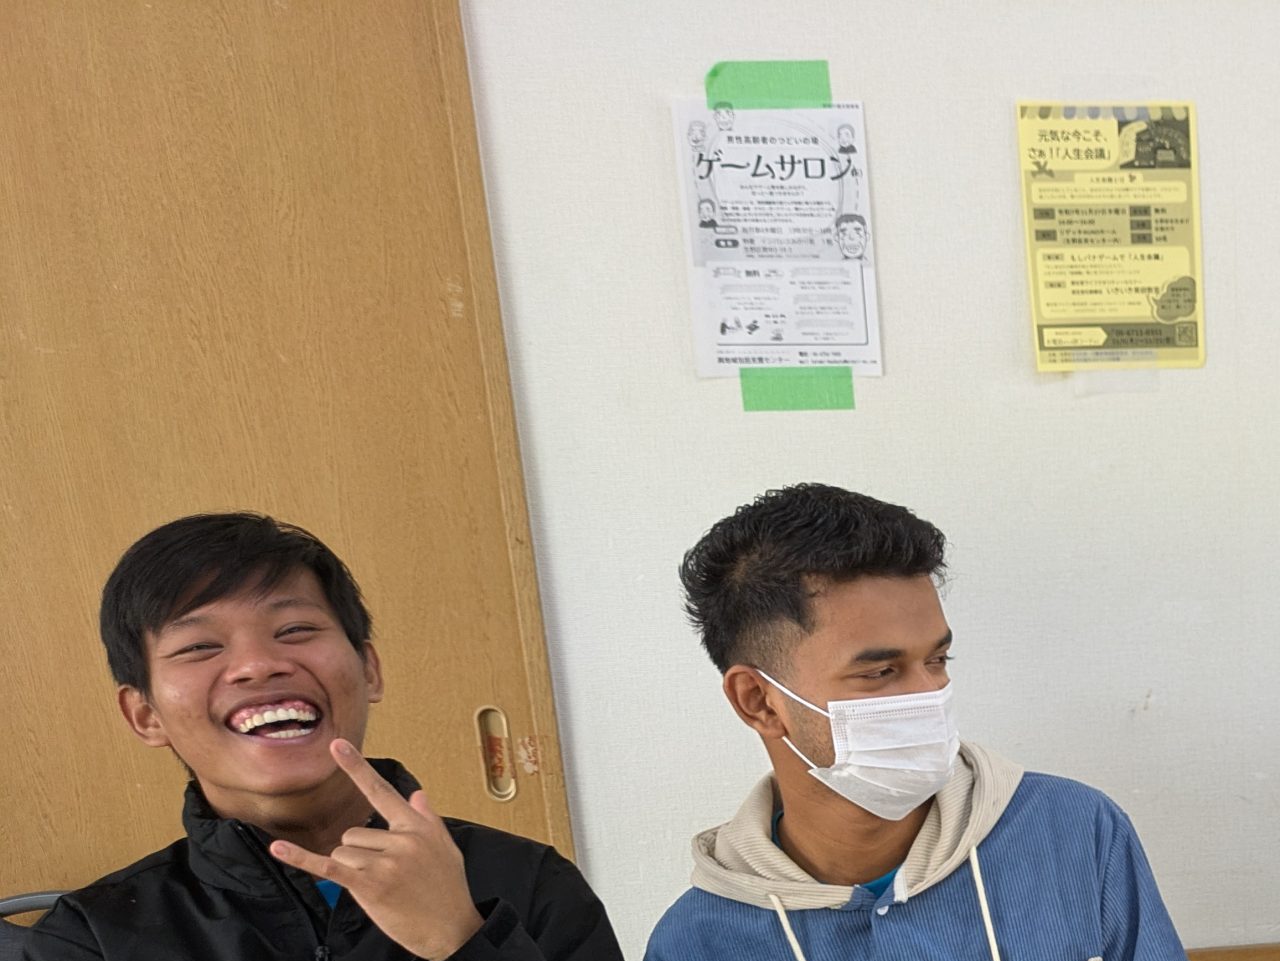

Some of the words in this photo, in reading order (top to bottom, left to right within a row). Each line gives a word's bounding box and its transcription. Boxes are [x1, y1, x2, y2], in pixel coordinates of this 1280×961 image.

[696, 149, 852, 181] ゲームサロン
